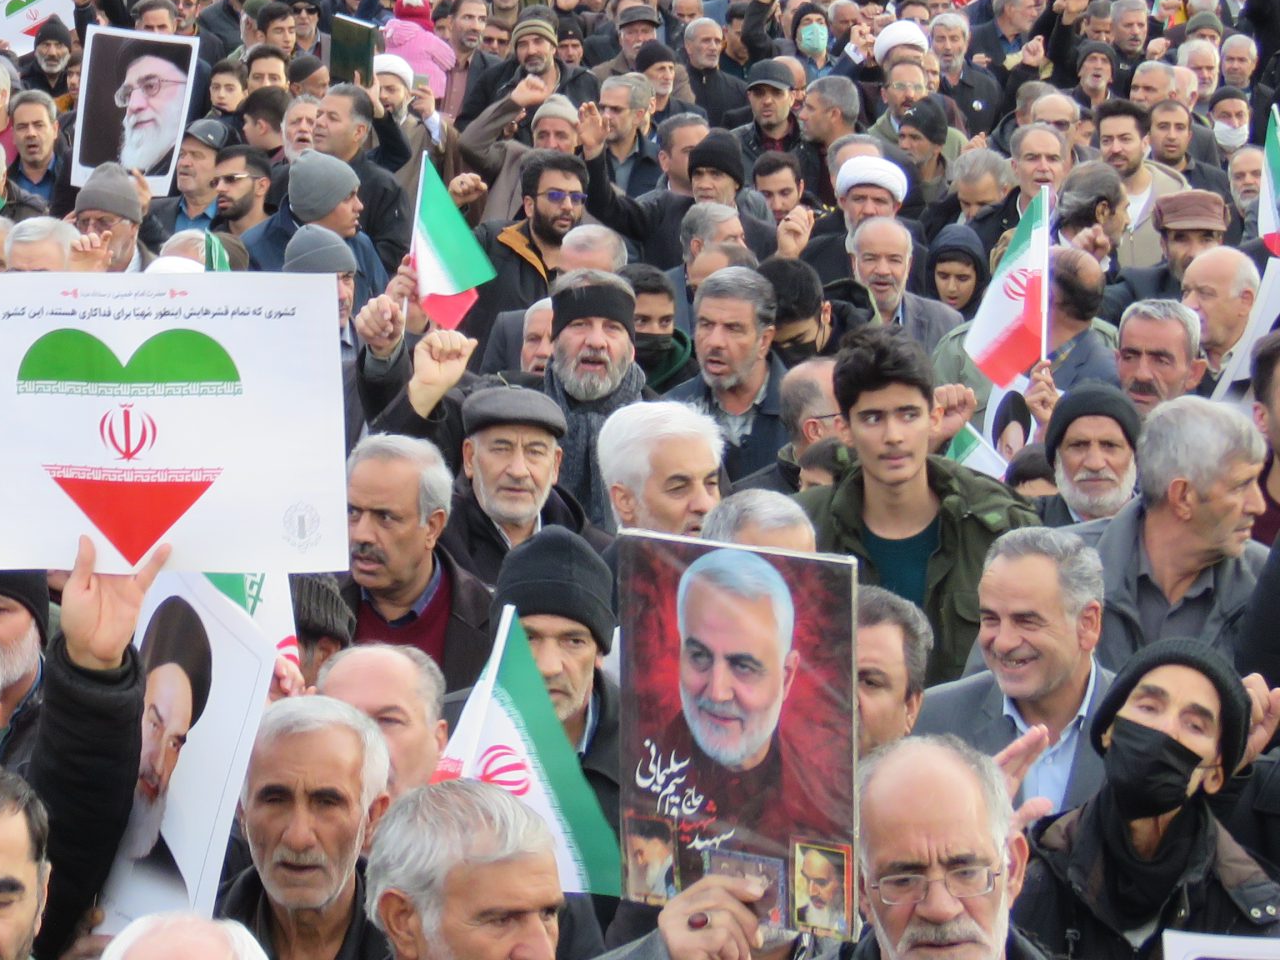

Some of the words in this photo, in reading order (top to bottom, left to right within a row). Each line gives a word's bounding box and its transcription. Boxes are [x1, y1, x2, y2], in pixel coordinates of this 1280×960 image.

[2, 306, 26, 320] کشور
[28, 306, 45, 319] این
[79, 305, 111, 320] فداکاری
[113, 305, 132, 320] برای
[154, 305, 182, 320] اینطور
[184, 305, 229, 319] قشرهایش
[231, 307, 249, 319] تمام
[252, 306, 262, 316] که
[265, 305, 297, 319] کشوری
[636, 739, 691, 793] سلیمانی
[682, 786, 704, 815] حاج
